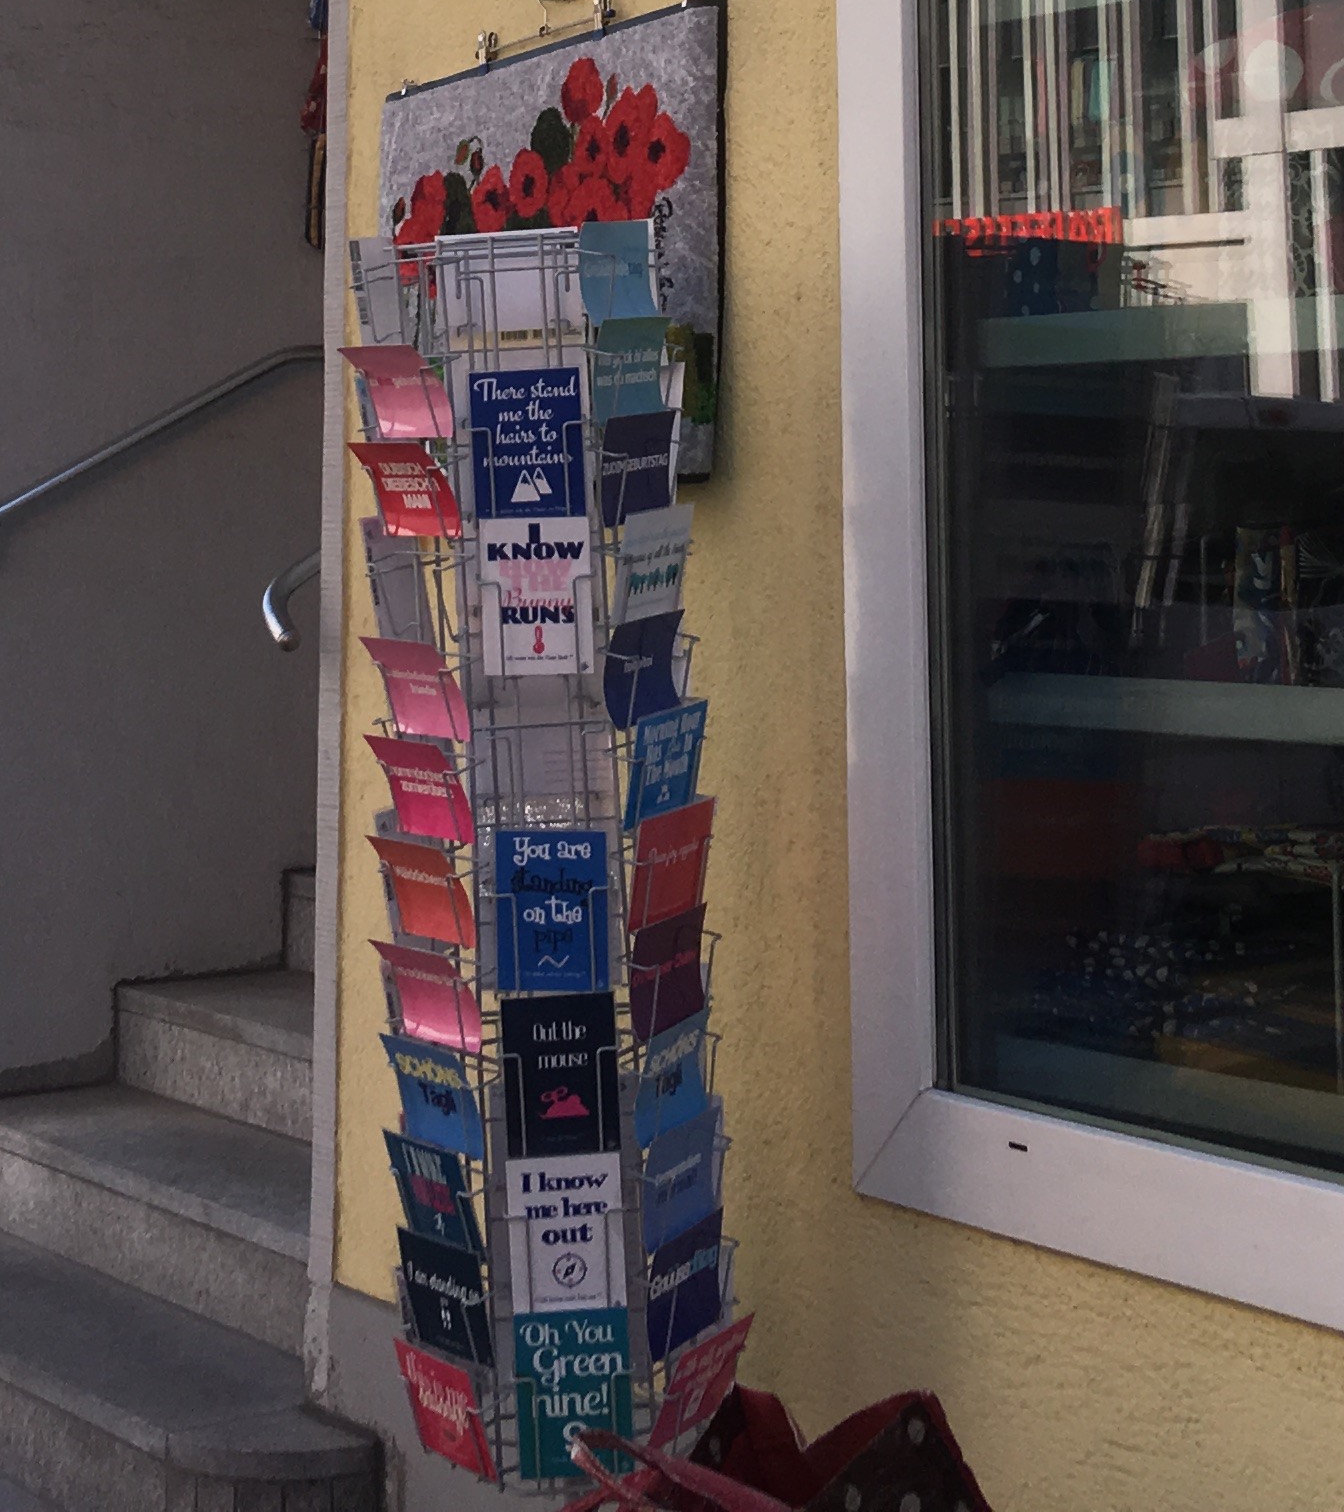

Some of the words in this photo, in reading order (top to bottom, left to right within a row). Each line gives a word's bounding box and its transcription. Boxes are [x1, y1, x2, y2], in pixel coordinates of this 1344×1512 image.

[473, 378, 525, 402] There
[531, 375, 577, 397] stand
[498, 410, 524, 422] me
[526, 399, 554, 420] the
[495, 424, 538, 444] hairs
[539, 422, 559, 442] to
[483, 445, 573, 467] mountains
[528, 523, 540, 543] I
[487, 541, 584, 561] KNOW
[503, 588, 573, 613] Bunny
[501, 605, 575, 624] RUNS
[513, 837, 551, 866] You
[557, 841, 591, 859] are
[523, 906, 545, 924] on
[545, 895, 582, 924] the
[533, 1021, 558, 1042] Out
[562, 1020, 587, 1040] the
[538, 1052, 588, 1070] mouse
[521, 1173, 532, 1193] I
[538, 1172, 608, 1192] know
[526, 1204, 558, 1220] me
[561, 1197, 608, 1218] here
[541, 1223, 593, 1245] out
[519, 1321, 561, 1346] Oh
[565, 1319, 615, 1344] You
[533, 1346, 625, 1391] Green
[533, 1382, 609, 1418] nine!
